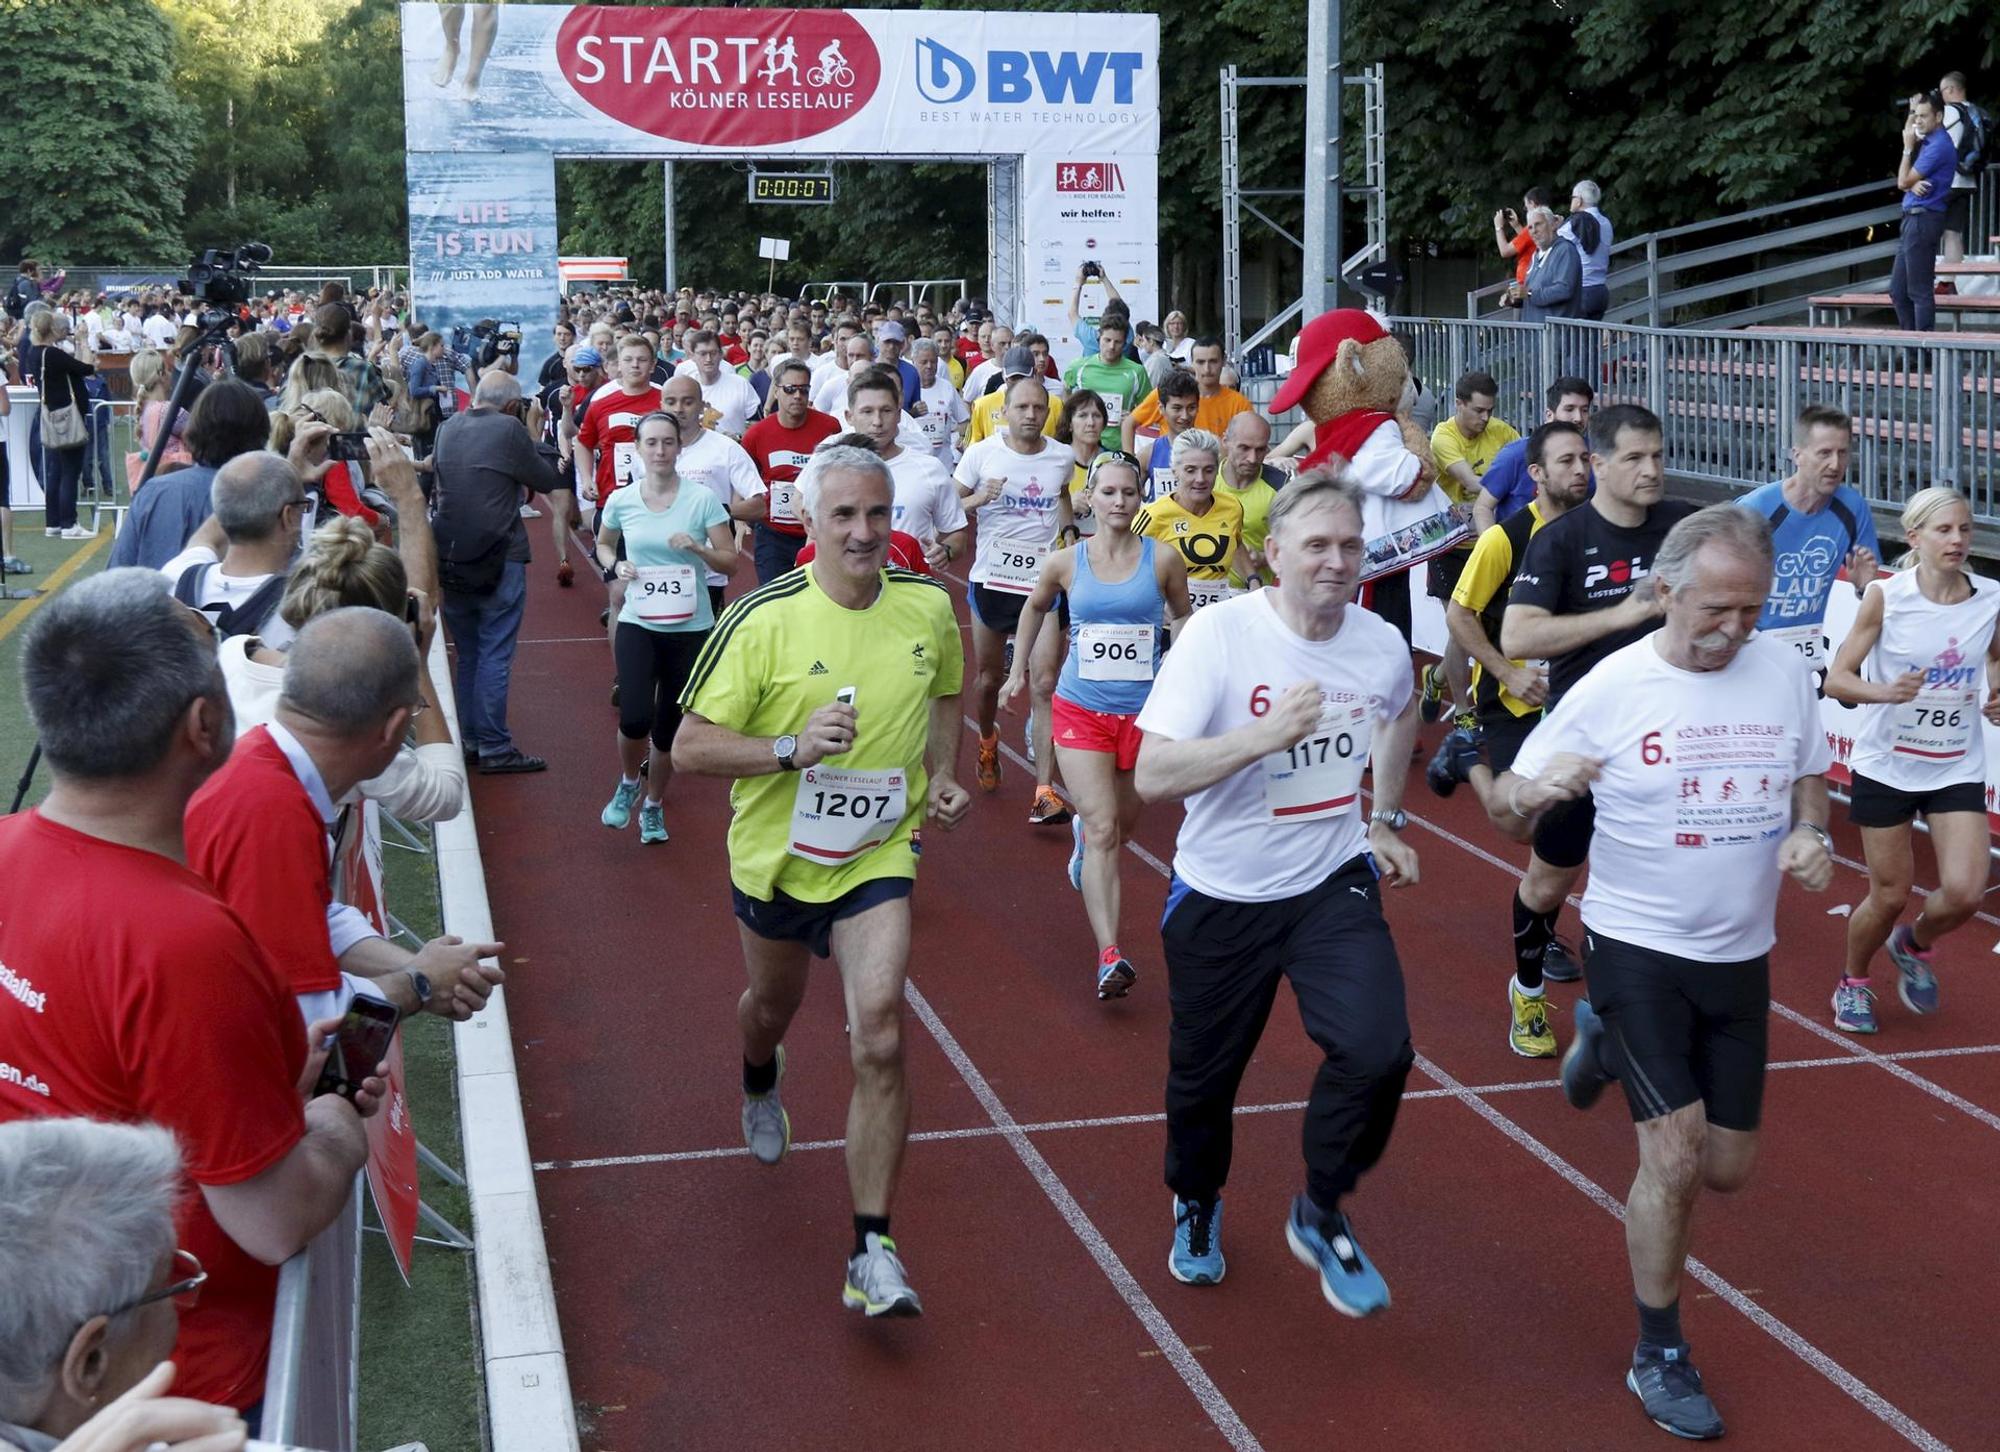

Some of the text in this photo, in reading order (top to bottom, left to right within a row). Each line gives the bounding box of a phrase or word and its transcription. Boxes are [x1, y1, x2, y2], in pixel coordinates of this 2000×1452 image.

[575, 35, 759, 85] START
[987, 50, 1143, 104] BWT
[670, 88, 854, 109] KÖLNER LESELAUF
[920, 111, 1141, 124] BEST WATER TECHNOLOGY
[758, 180, 828, 197] 0:00:07
[458, 201, 509, 224] LIFE
[1060, 209, 1079, 218] wir
[1081, 209, 1115, 218] helfen
[436, 230, 534, 256] IS FUN
[449, 270, 475, 281] JUST
[478, 270, 503, 281] ADD
[505, 269, 544, 280] WATER
[1018, 497, 1055, 508] BWT
[1175, 522, 1188, 532] FC
[1002, 552, 1036, 569] 789
[1776, 552, 1829, 577] GVG
[644, 581, 682, 596] 943
[1588, 587, 1628, 599] LISTENS
[1188, 593, 1219, 607] 935
[1093, 642, 1137, 661] 906
[1926, 667, 1976, 683] BWT
[1915, 708, 1962, 727] 786
[1286, 732, 1354, 770] 1170
[1640, 731, 1672, 766] 6.
[1677, 724, 1729, 739] KÖLNER
[1733, 723, 1785, 737] LESELAUF
[806, 769, 883, 785] 6. KÖLNER LESELAUF
[815, 791, 890, 819] 1207
